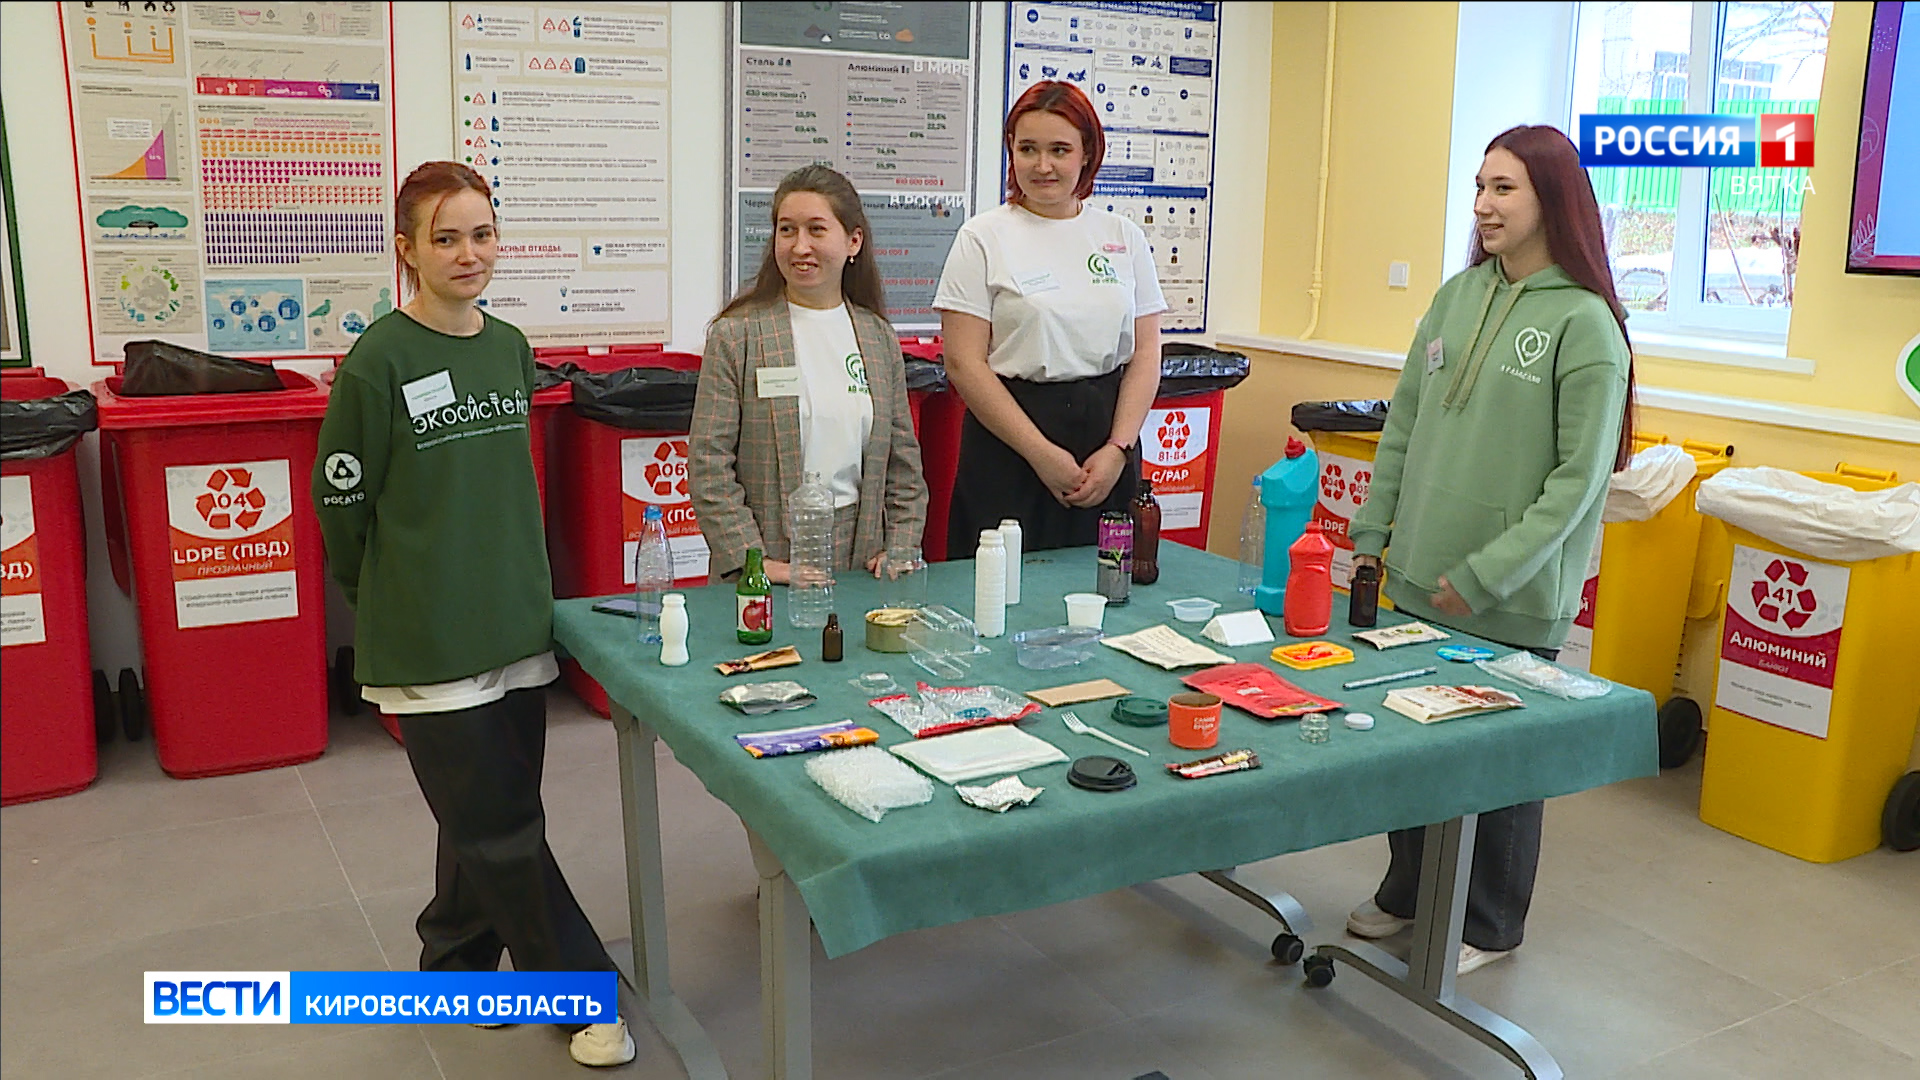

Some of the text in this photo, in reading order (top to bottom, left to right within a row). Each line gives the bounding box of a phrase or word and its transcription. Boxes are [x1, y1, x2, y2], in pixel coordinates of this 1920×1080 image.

[661, 463, 684, 477] 06
[1151, 468, 1190, 483] C/PAP
[217, 491, 247, 509] 04
[173, 540, 290, 565] LDPE (ПВД)
[197, 560, 275, 577] ПРОЗРАЧНЫЙ
[1771, 587, 1794, 605] 41
[1729, 630, 1828, 670] Алюминий
